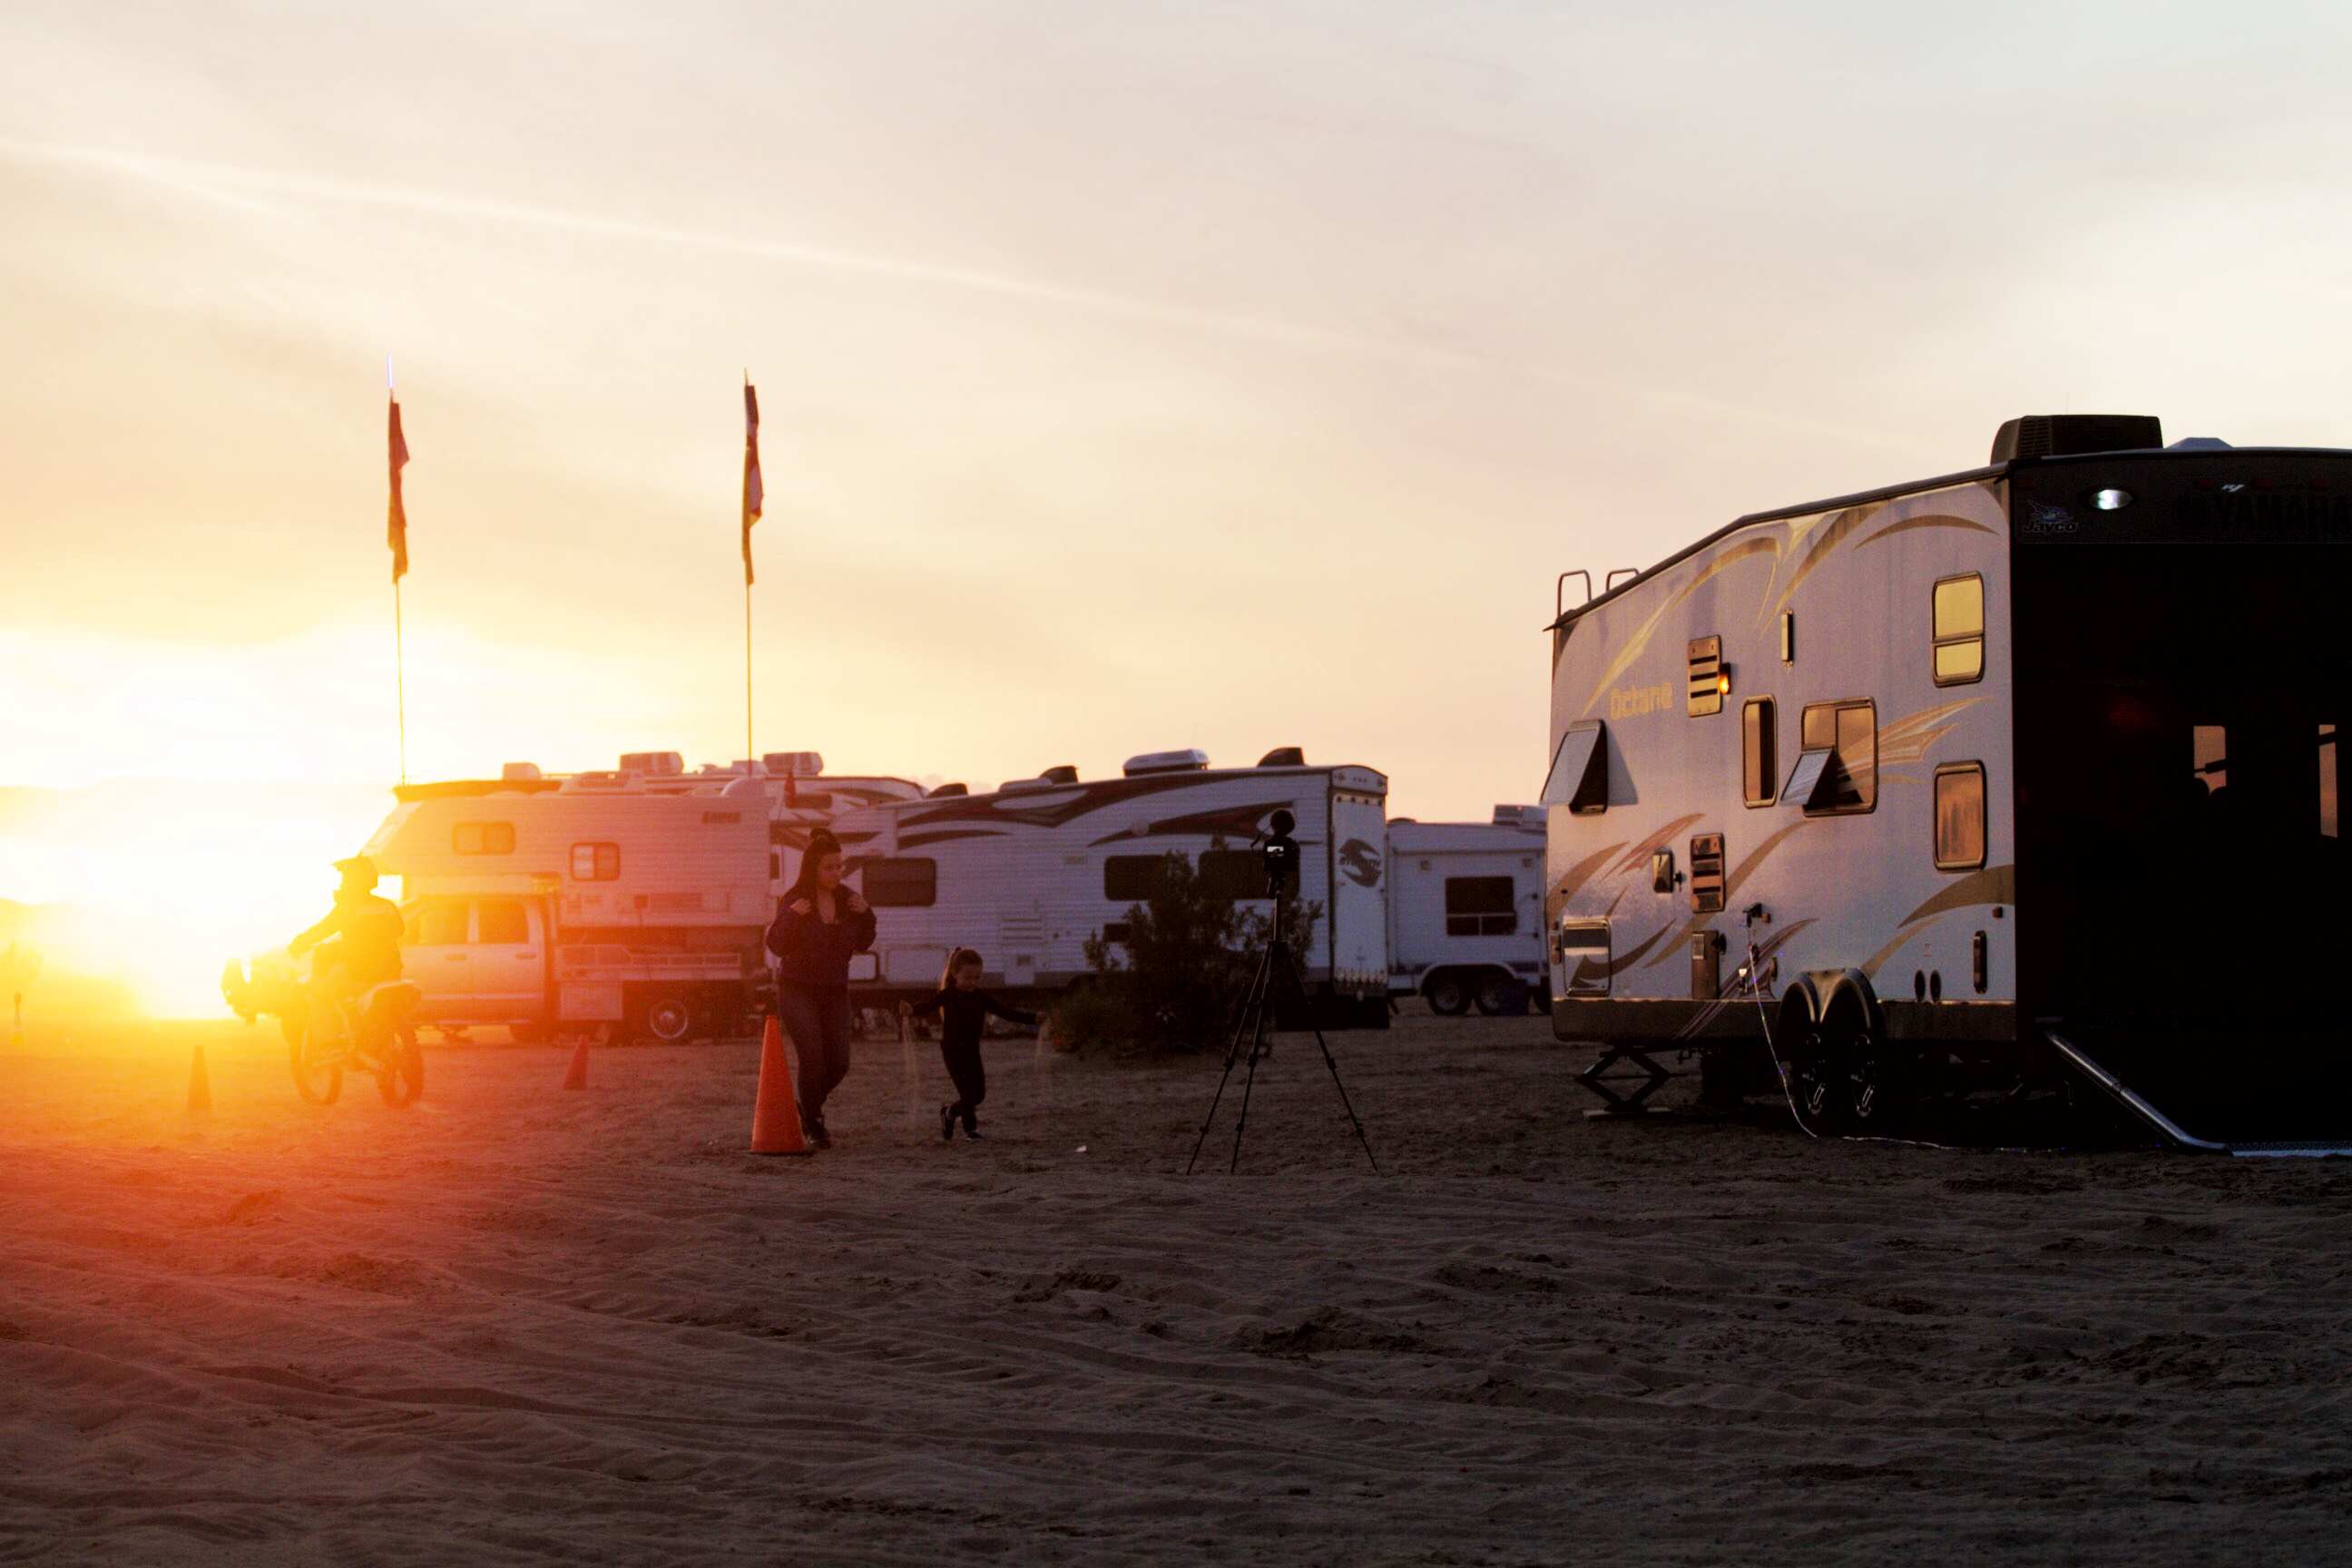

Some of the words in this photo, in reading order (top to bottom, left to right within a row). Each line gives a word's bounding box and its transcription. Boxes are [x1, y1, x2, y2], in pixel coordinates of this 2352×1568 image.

[2023, 518, 2078, 534] Jayco
[2214, 495, 2352, 532] YAMAHA
[1609, 682, 1673, 720] Octane
